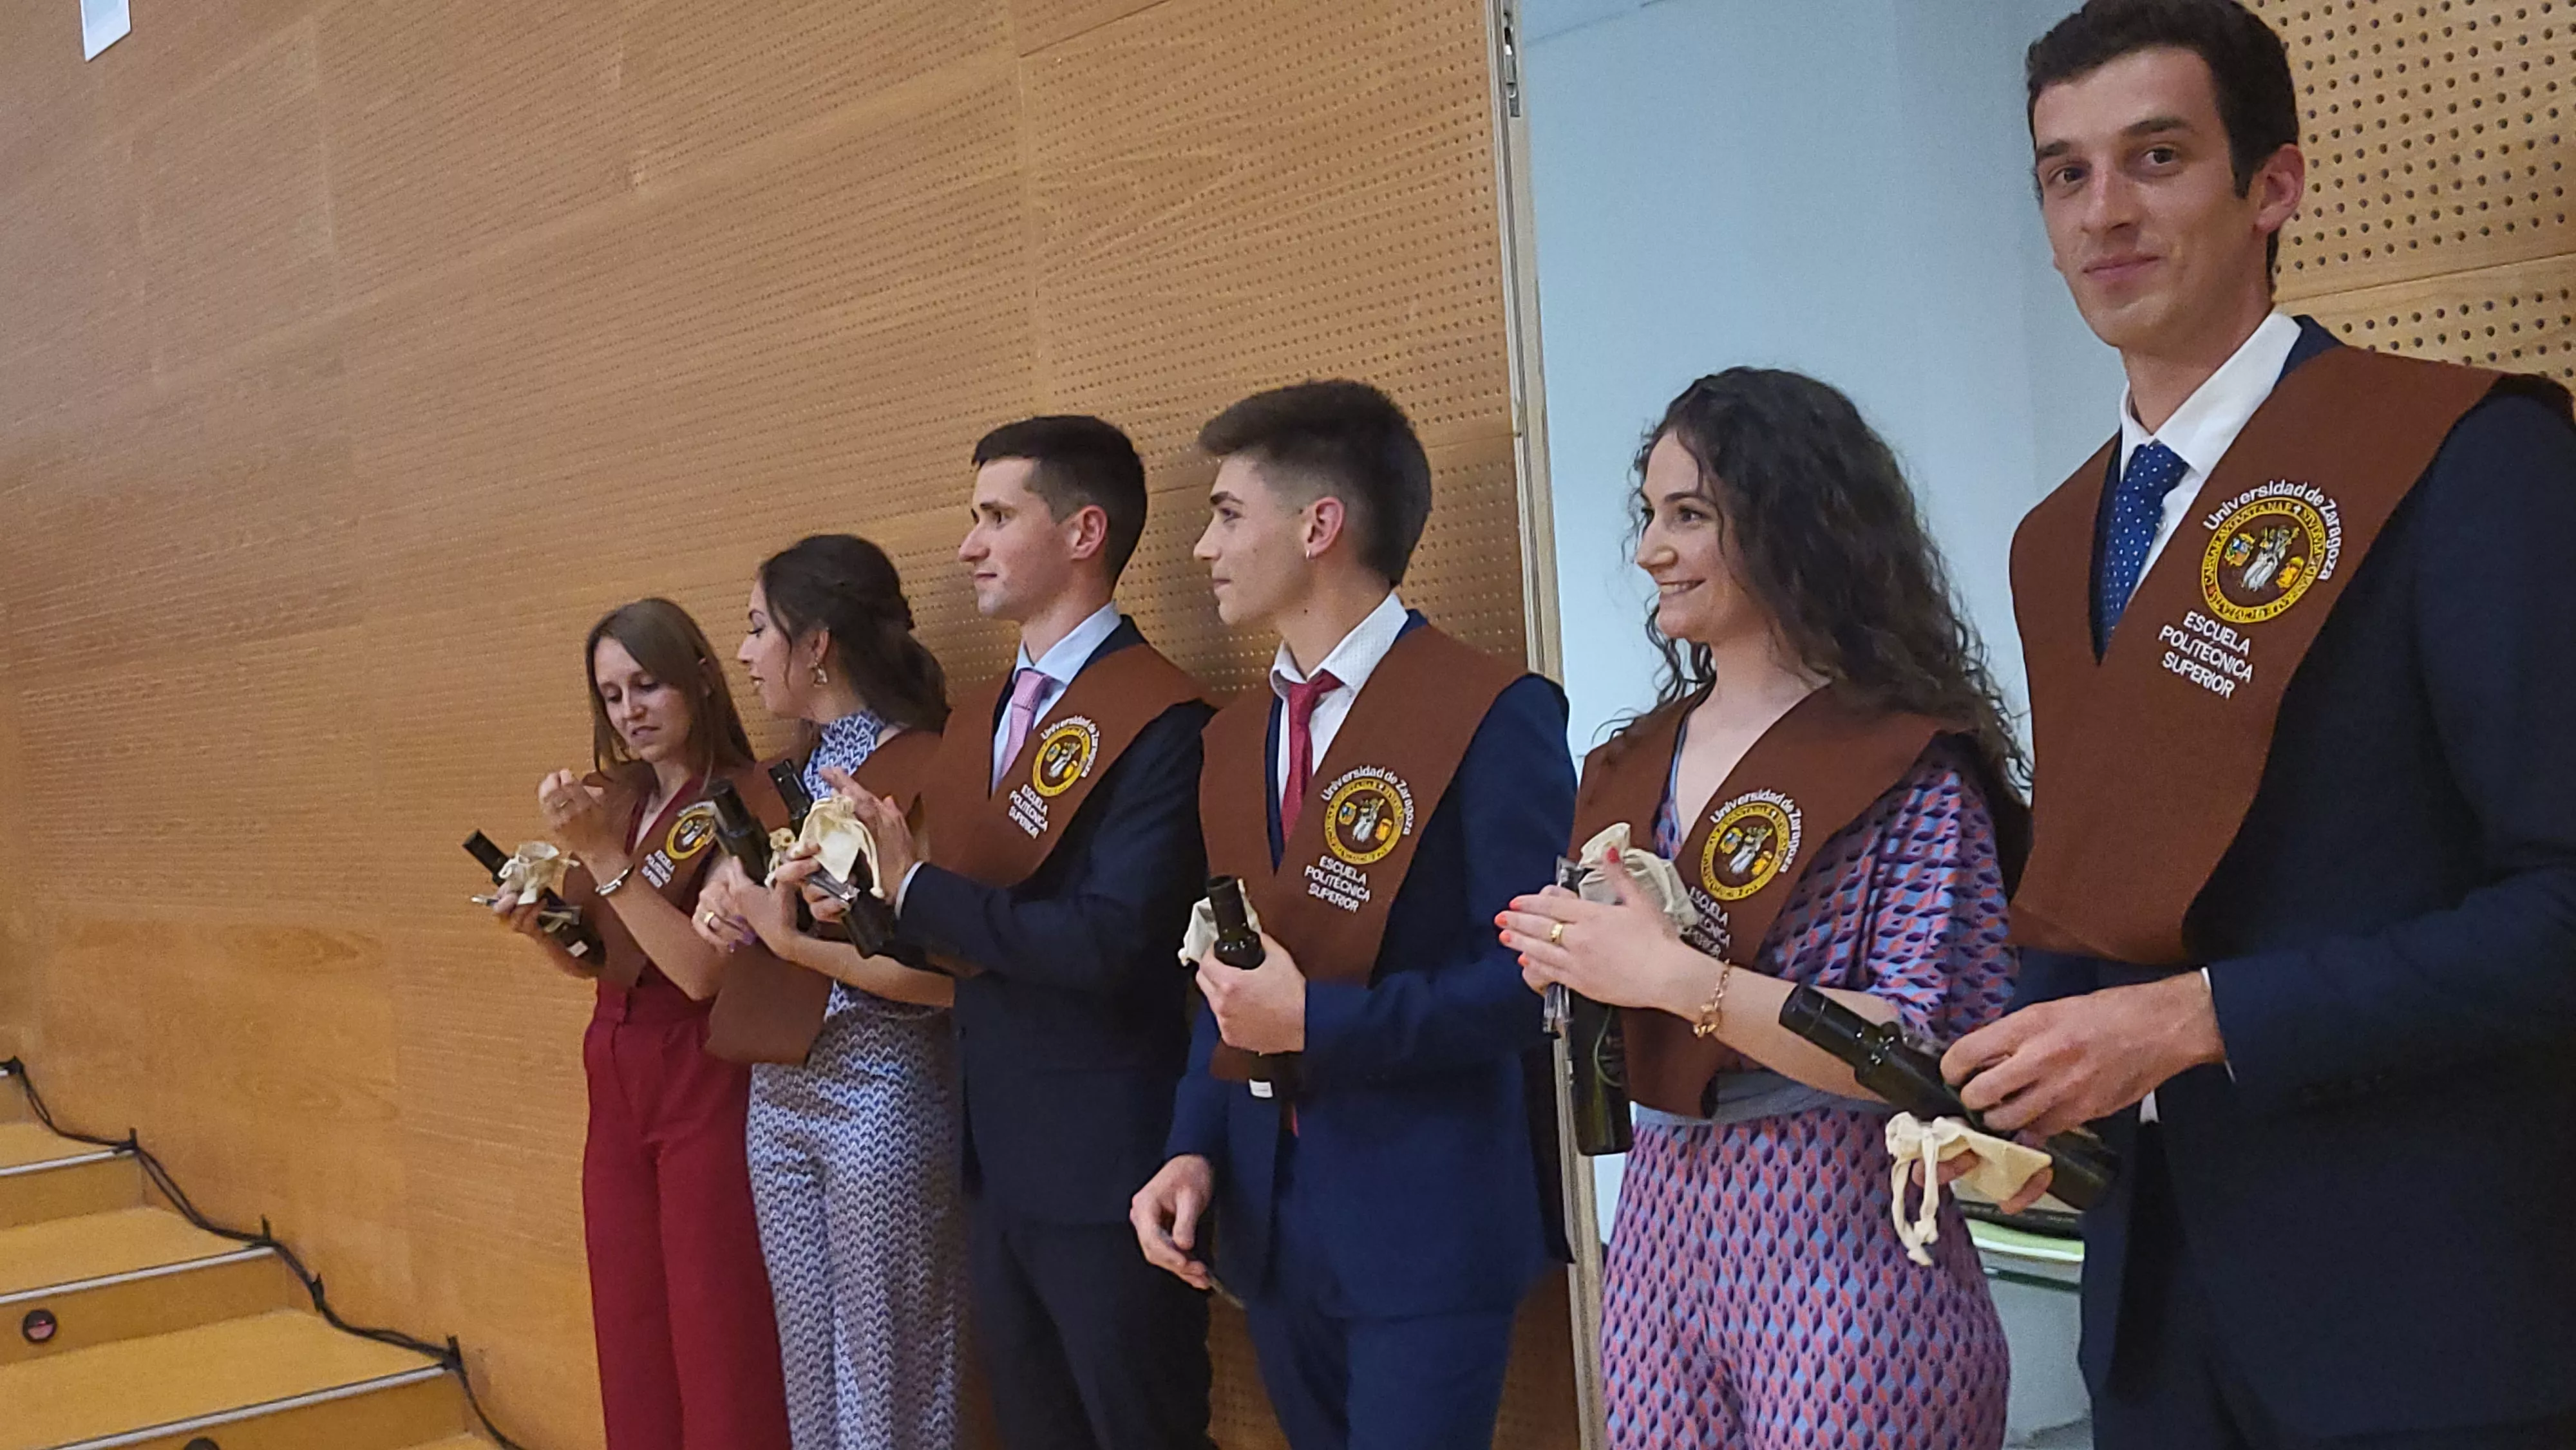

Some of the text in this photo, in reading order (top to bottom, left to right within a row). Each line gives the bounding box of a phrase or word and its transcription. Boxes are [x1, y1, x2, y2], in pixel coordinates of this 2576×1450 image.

[2204, 480, 2342, 579] Universidad de Zaragoza
[2159, 626, 2253, 683] POLITÉCNICA
[2183, 611, 2250, 656] ESCUELA
[2163, 651, 2235, 698] SUPERIOR
[1321, 764, 1385, 801] Universidad
[1385, 771, 1399, 784] de
[1396, 780, 1414, 835] Zaragoza
[1710, 789, 1783, 823] Universidad
[1319, 855, 1367, 884] ESCUELA
[1308, 883, 1358, 912] SUPERIOR
